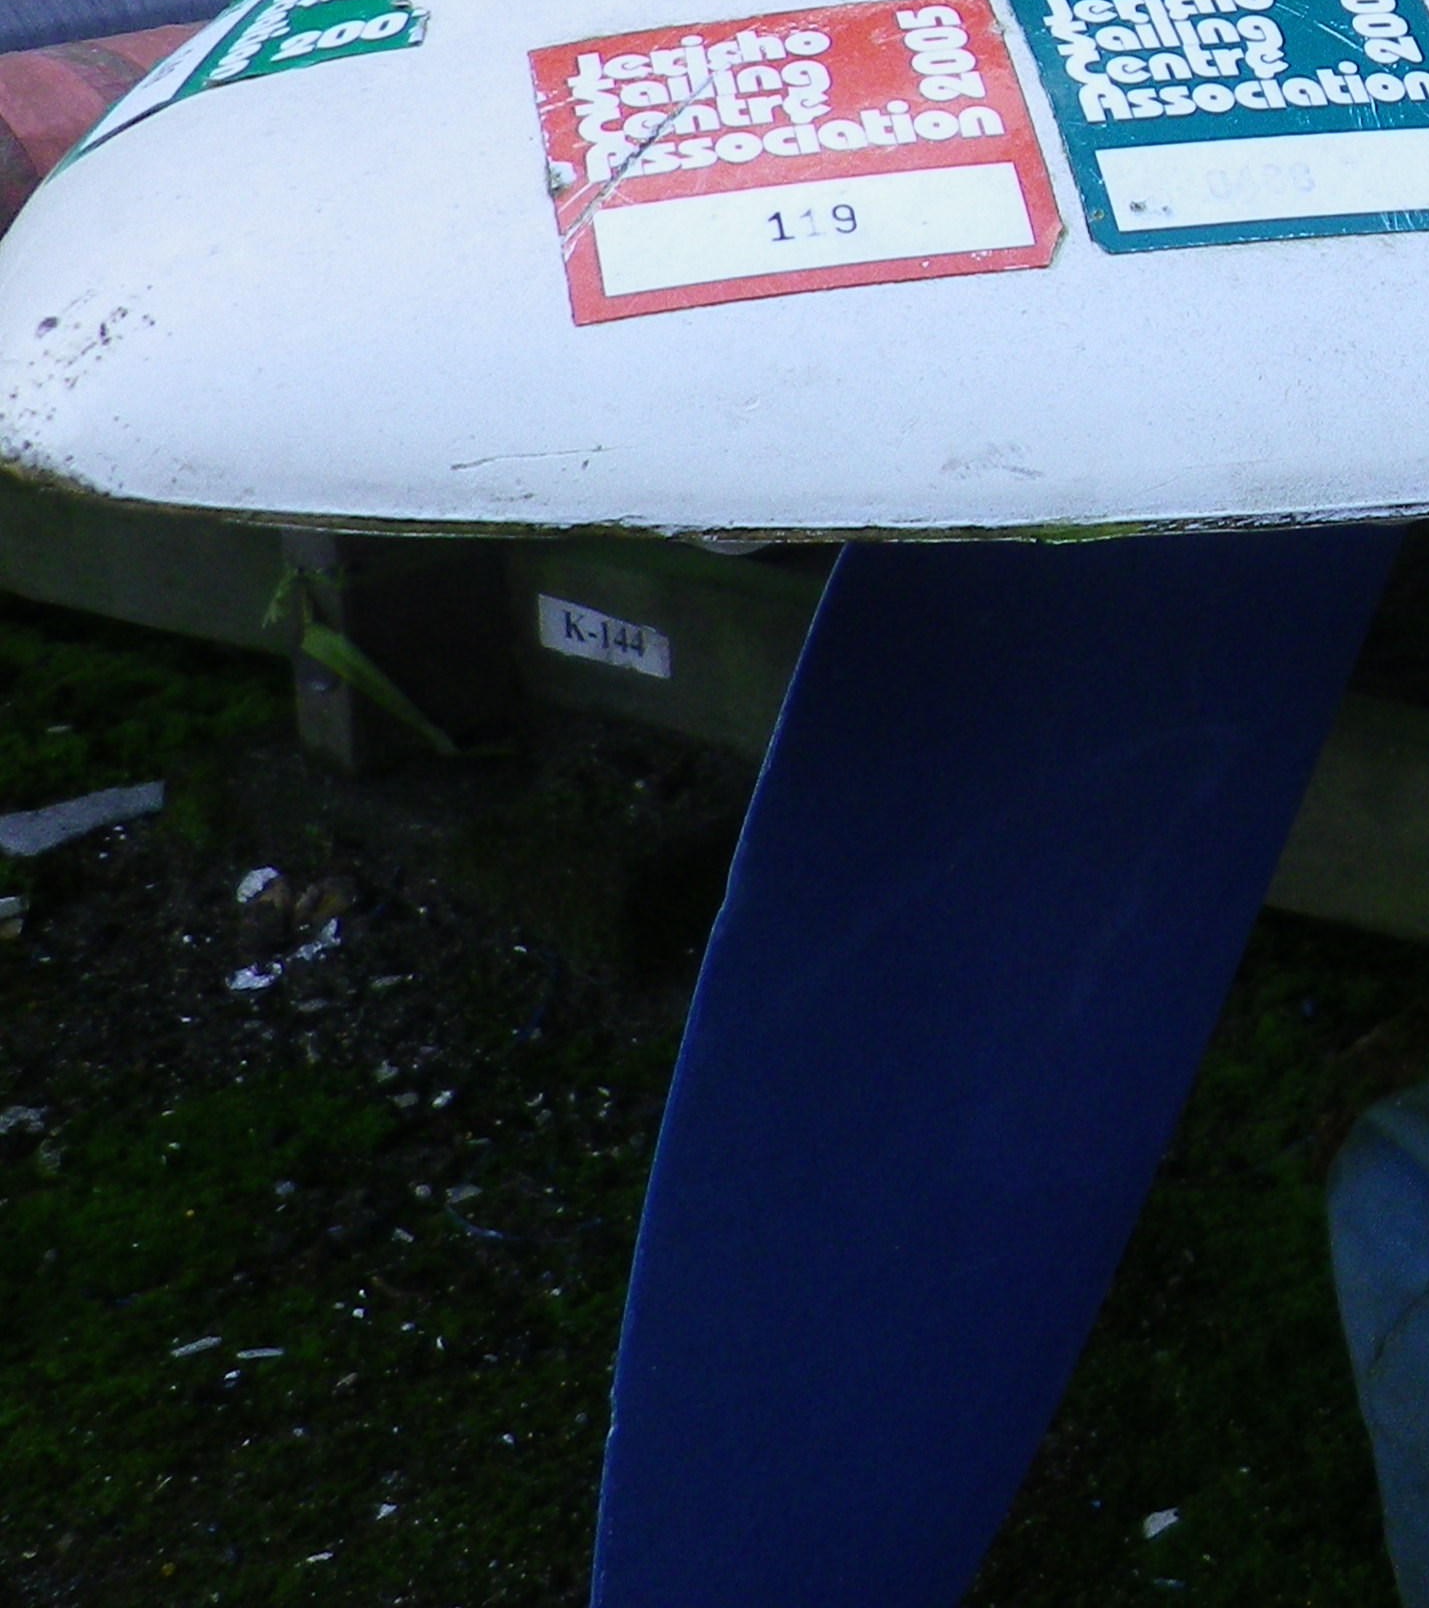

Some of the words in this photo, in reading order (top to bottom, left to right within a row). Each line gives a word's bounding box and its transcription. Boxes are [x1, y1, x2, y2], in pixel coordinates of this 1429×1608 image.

[567, 30, 832, 95] Jericho
[896, 4, 986, 103] 2005
[1046, 15, 1284, 60] Sailing
[571, 59, 832, 118] Sailing
[1058, 44, 1290, 85] Centre
[575, 92, 832, 145] Centre
[584, 99, 1007, 184] Association
[767, 203, 858, 243] 119
[562, 609, 645, 657] K-144
